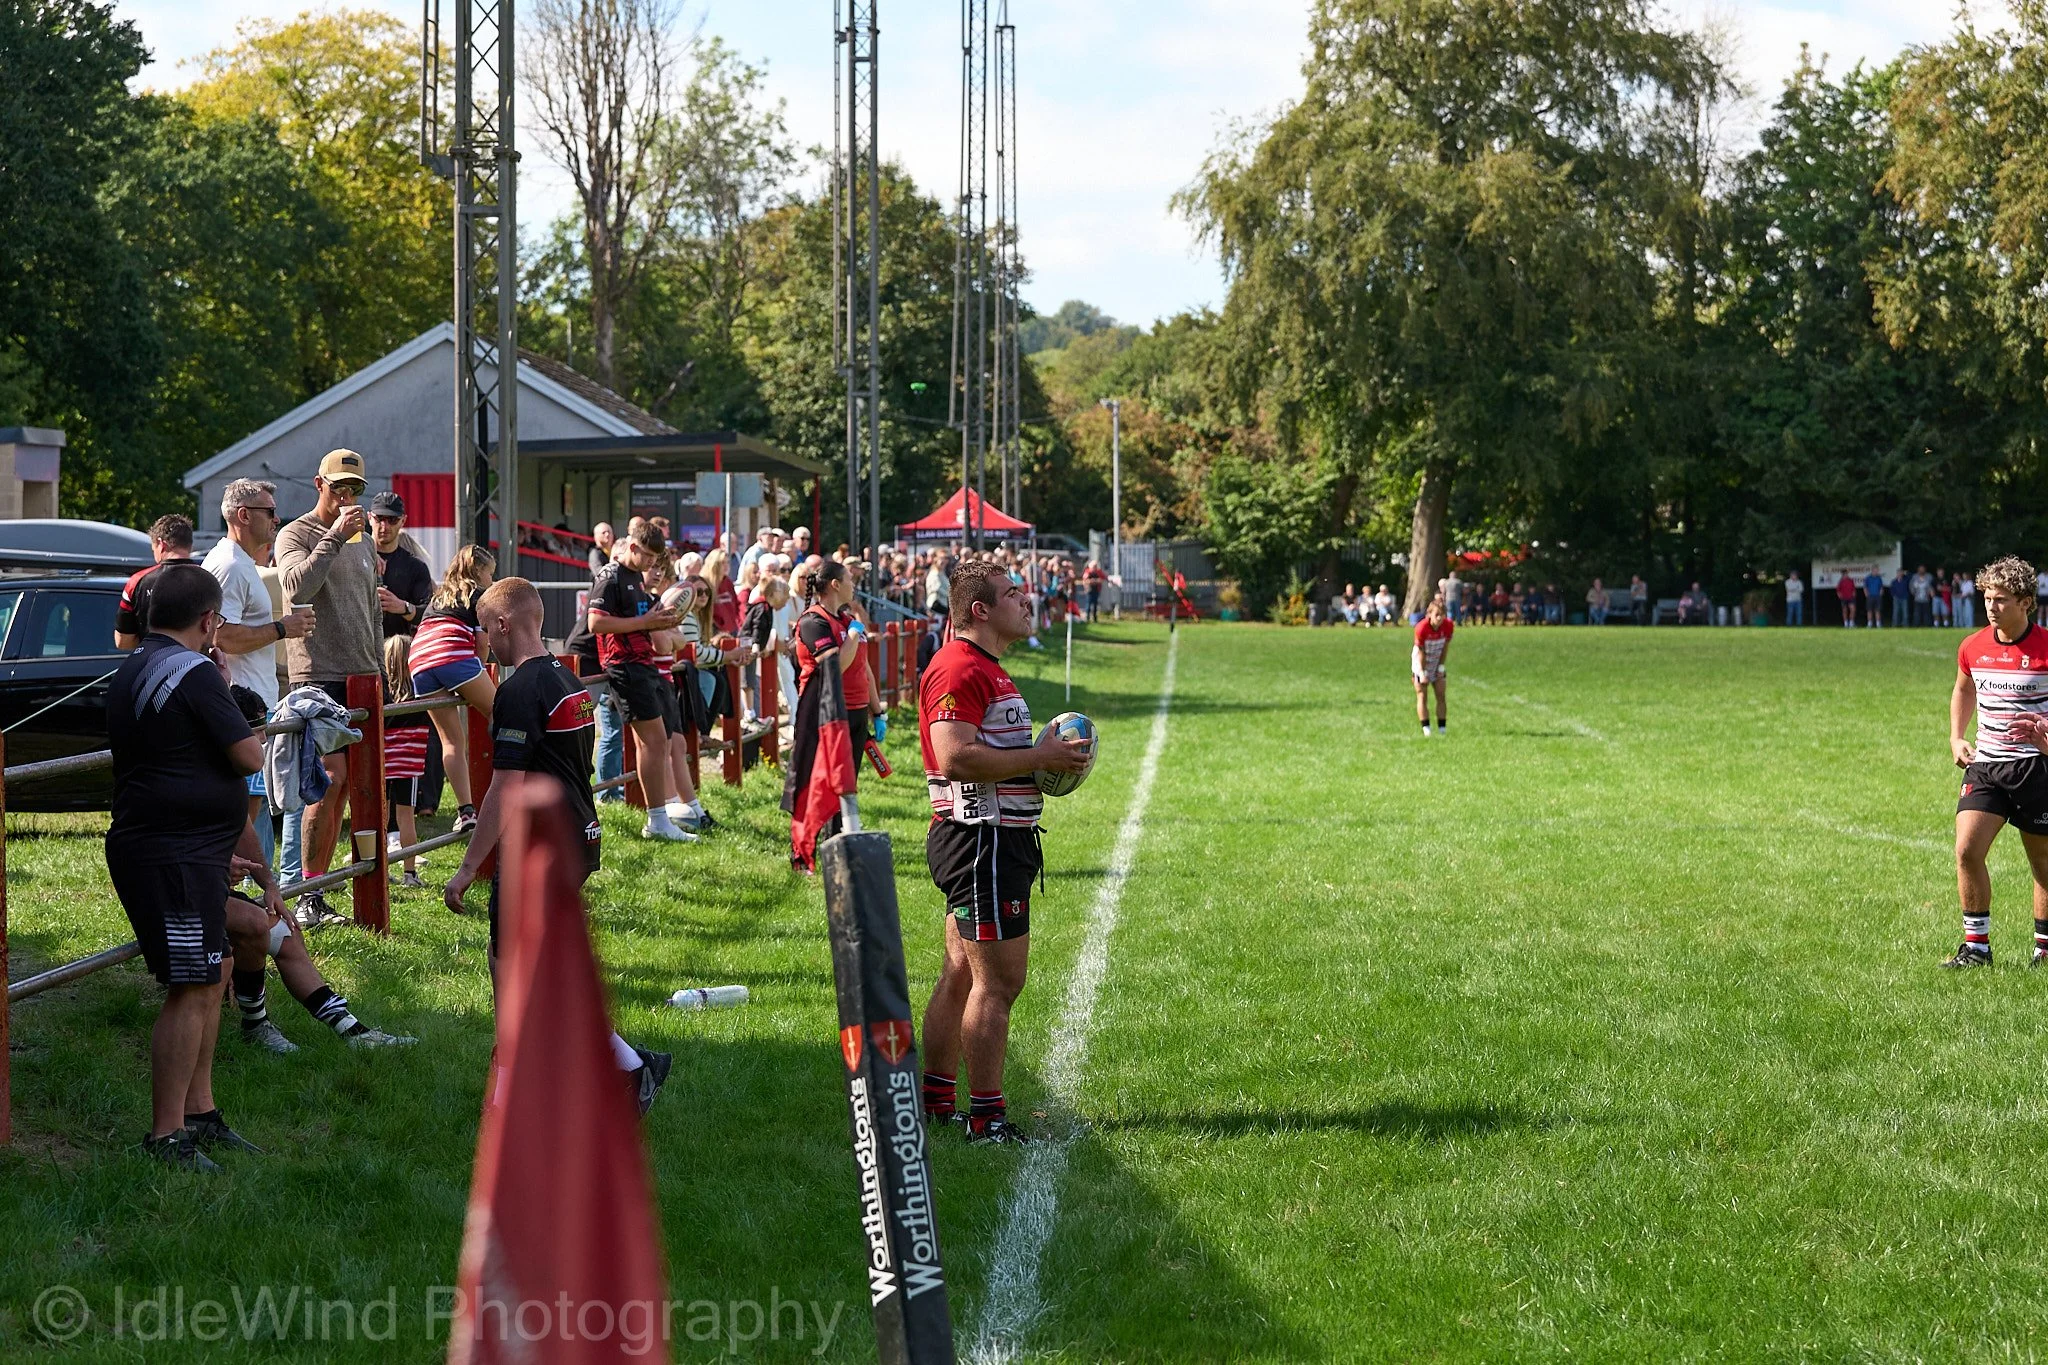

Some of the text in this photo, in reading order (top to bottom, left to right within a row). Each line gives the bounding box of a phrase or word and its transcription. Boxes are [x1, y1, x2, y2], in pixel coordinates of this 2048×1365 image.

[1989, 681, 2037, 691] foodstores
[1006, 706, 1023, 725] CK
[961, 781, 980, 819] EME
[850, 1077, 898, 1307] Worthington's
[887, 1071, 945, 1300] Worthington's
